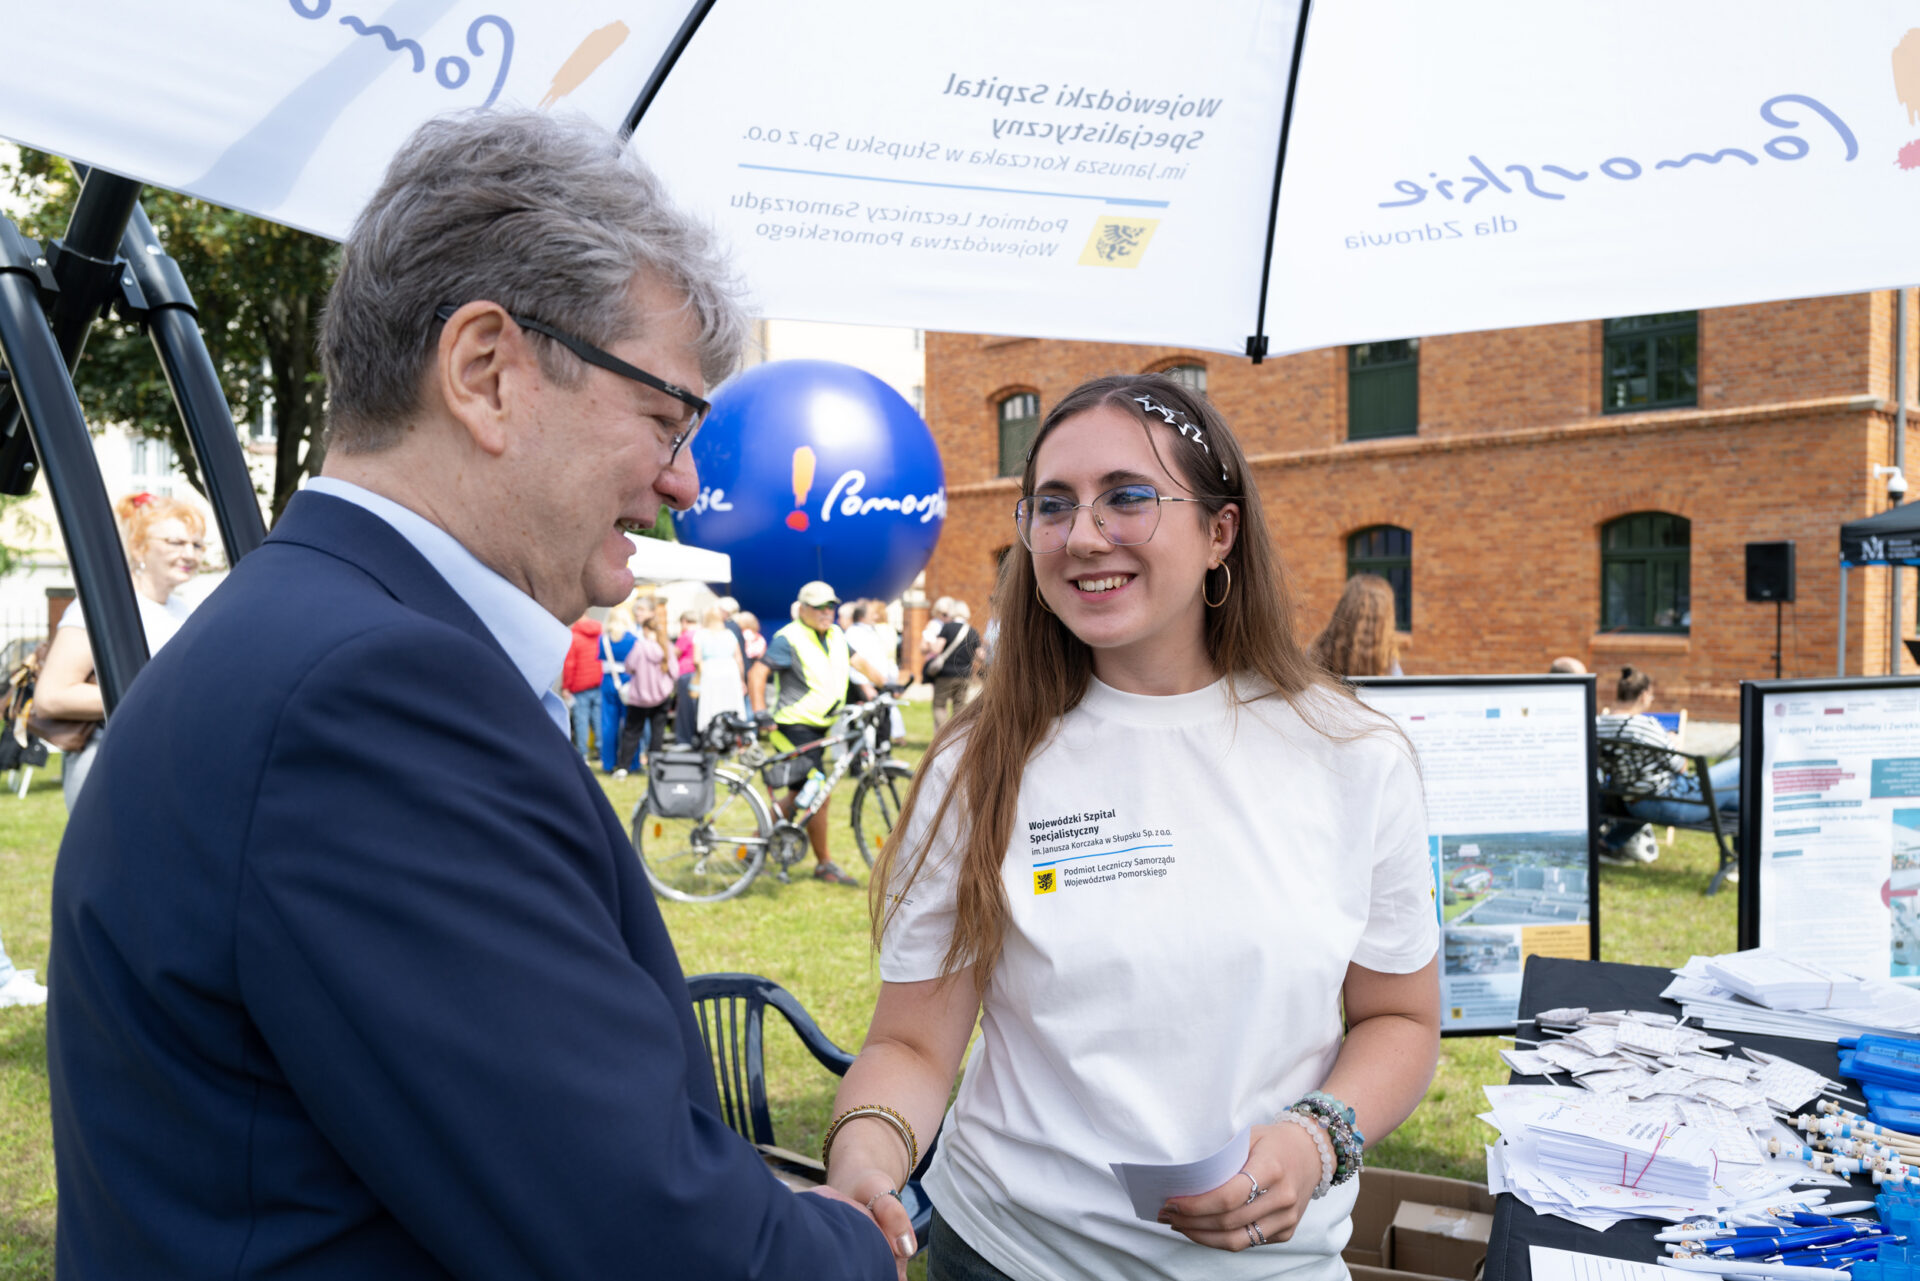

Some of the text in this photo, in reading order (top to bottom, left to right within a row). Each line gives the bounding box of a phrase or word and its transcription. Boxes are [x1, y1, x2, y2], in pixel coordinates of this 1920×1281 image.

[1029, 809, 1116, 831] Wojewódzki Szpital
[1030, 826, 1099, 844] Specjalistyczny
[1071, 838, 1103, 849] Korczaka
[1112, 831, 1141, 843] Słupsku
[1143, 829, 1153, 838] Sp.
[1064, 855, 1175, 876] Podmiot Leczniczy Samorządu
[1064, 867, 1167, 887] Województwa Pomorskiego
